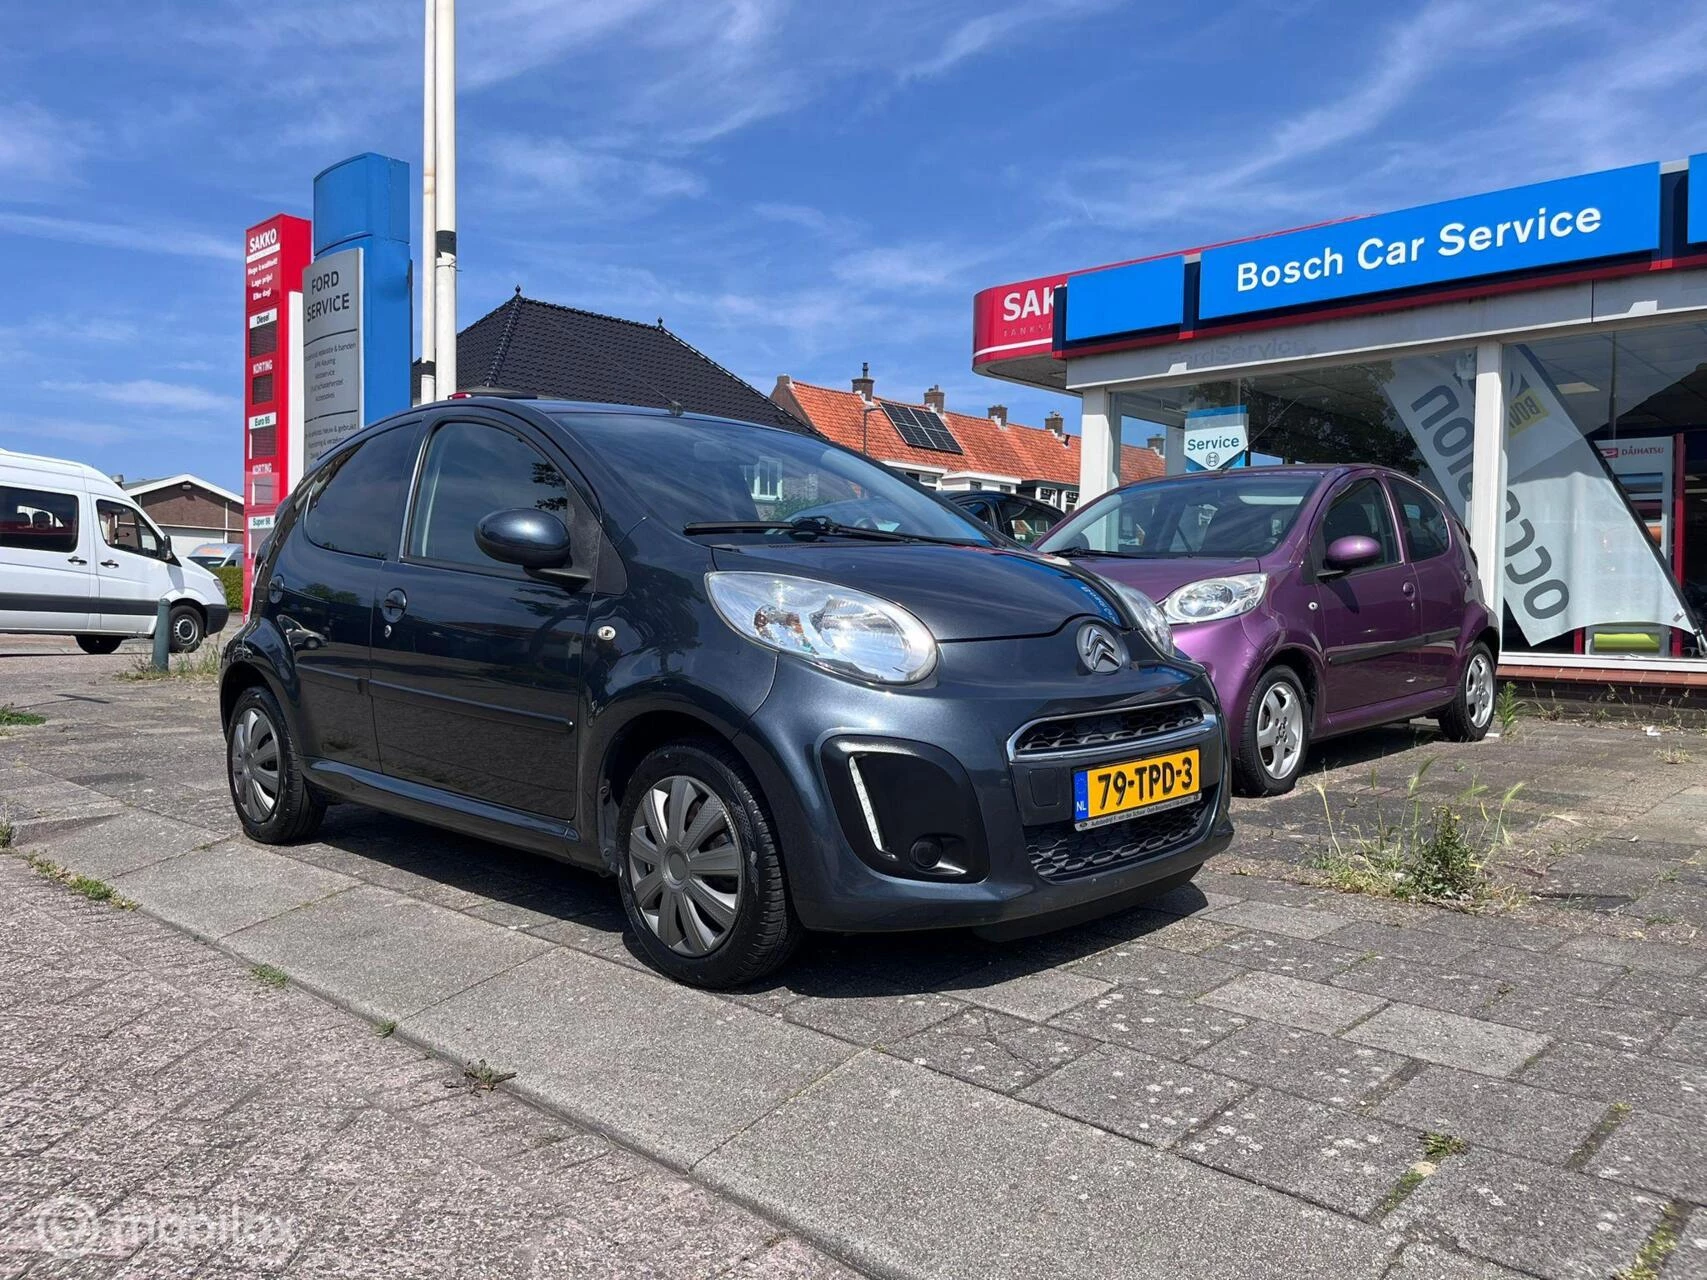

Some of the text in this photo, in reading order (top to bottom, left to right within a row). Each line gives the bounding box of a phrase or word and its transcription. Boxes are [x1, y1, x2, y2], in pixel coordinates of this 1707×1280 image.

[250, 228, 277, 253] SAKKO
[1236, 206, 1602, 292] Bosch Car Service
[311, 271, 339, 295] FORD
[307, 292, 350, 322] SERVICE
[1003, 282, 1060, 321] SAK
[256, 312, 270, 325] Diesel
[253, 360, 273, 374] KORTING
[254, 417, 265, 427] Euro
[1187, 436, 1240, 451] Service
[252, 462, 272, 475] KORTING
[253, 517, 265, 527] Super
[1097, 756, 1193, 810] 79-TPD-3
[1076, 800, 1087, 812] NL
